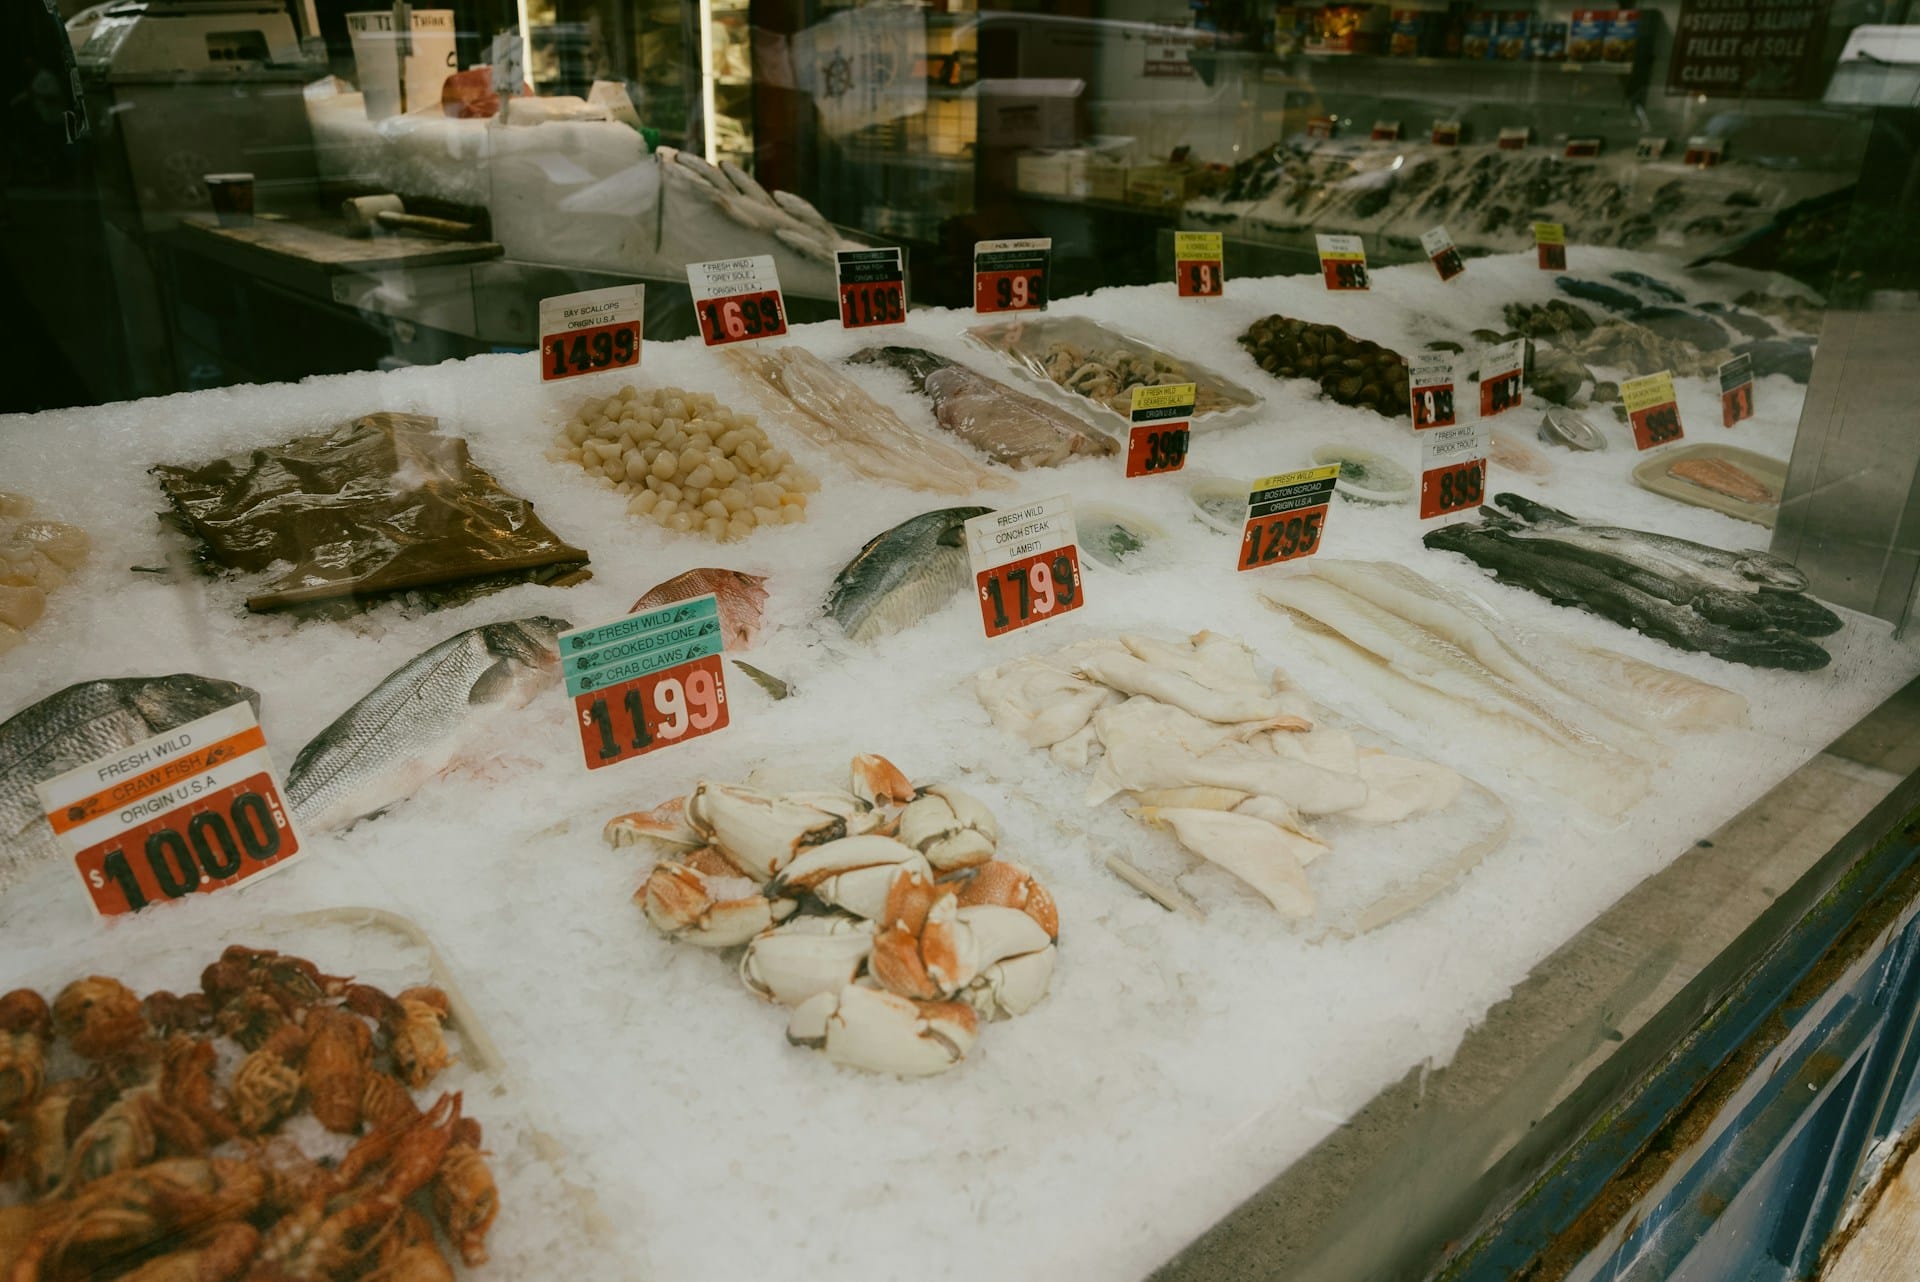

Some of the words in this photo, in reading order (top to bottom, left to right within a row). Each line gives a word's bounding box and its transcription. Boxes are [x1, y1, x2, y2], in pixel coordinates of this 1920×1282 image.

[1686, 37, 1741, 57] FILLET
[1762, 37, 1806, 57] SOLE
[1681, 65, 1740, 82] CLAMS
[707, 263, 731, 272] FRESH
[732, 260, 750, 269] WILD
[563, 308, 579, 318] BAY
[580, 302, 620, 316] SCALLOPS
[567, 318, 595, 329] ORIGIN
[1438, 431, 1457, 440] FRESH
[1458, 427, 1471, 436] WILD
[1456, 439, 1474, 449] TROUT
[1272, 475, 1295, 486] FRESH
[1296, 471, 1314, 481] WILD
[1264, 488, 1293, 500] BOSTON
[1293, 483, 1322, 495] SCROAD
[997, 512, 1023, 526] FRESH
[1024, 506, 1044, 518] WILD
[1270, 501, 1294, 512] ORIGIN
[995, 529, 1023, 544] CONCH
[1024, 521, 1050, 535] STEAK
[1009, 541, 1042, 557] (LAMBIT)
[598, 621, 639, 641] FRESH
[641, 613, 671, 628] WILD
[603, 638, 654, 661] COOKED
[656, 625, 696, 645] STONE
[606, 661, 640, 681] CRAB
[642, 650, 683, 669] CLAWS
[714, 671, 724, 705] LB
[97, 750, 152, 782] FRESH
[152, 734, 192, 758] WILD
[111, 774, 161, 802] CRAW
[165, 755, 201, 778] FISH
[120, 796, 175, 825] ORIGIN
[176, 775, 217, 800] U.S.A
[265, 791, 286, 829] LB
